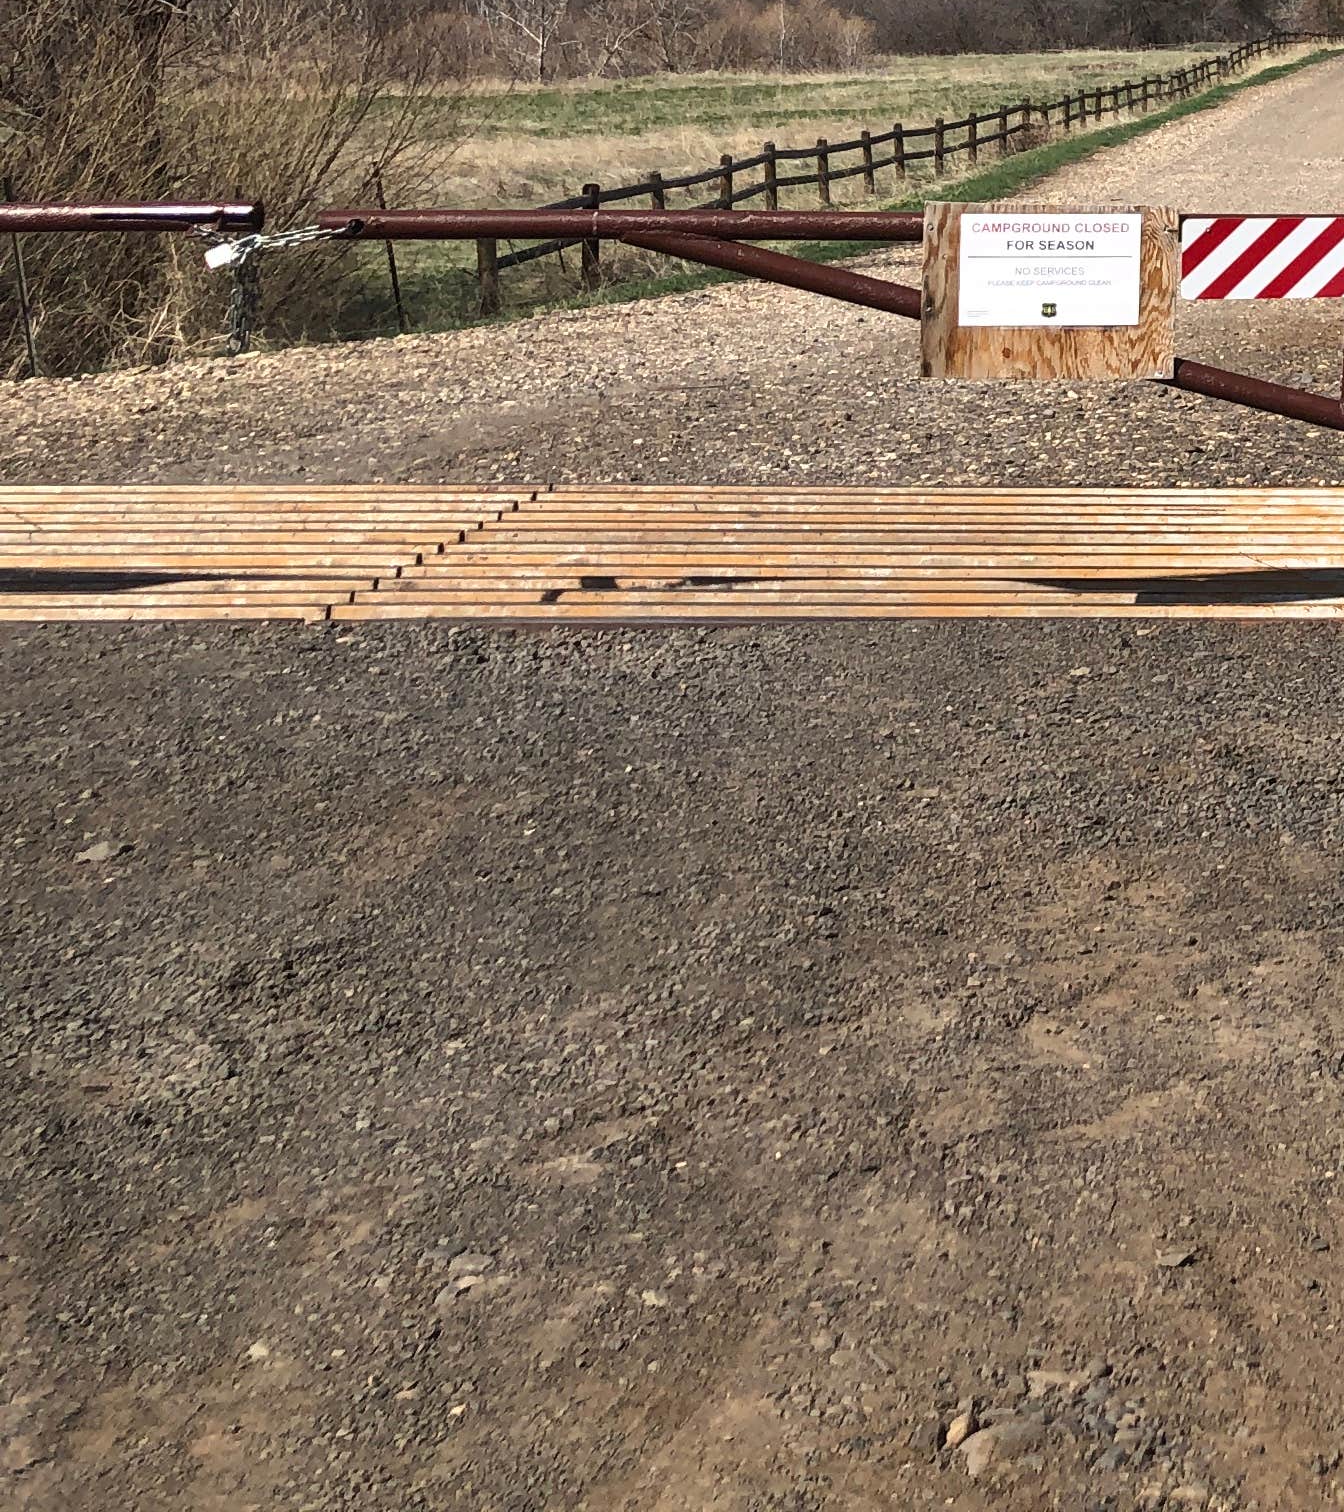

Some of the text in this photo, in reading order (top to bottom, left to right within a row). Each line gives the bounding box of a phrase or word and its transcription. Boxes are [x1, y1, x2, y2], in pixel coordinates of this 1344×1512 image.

[972, 223, 1130, 233] CAMPGROUND CLOSED
[1006, 240, 1095, 250] FOR SEASON
[1015, 267, 1085, 276] NO SERVICES
